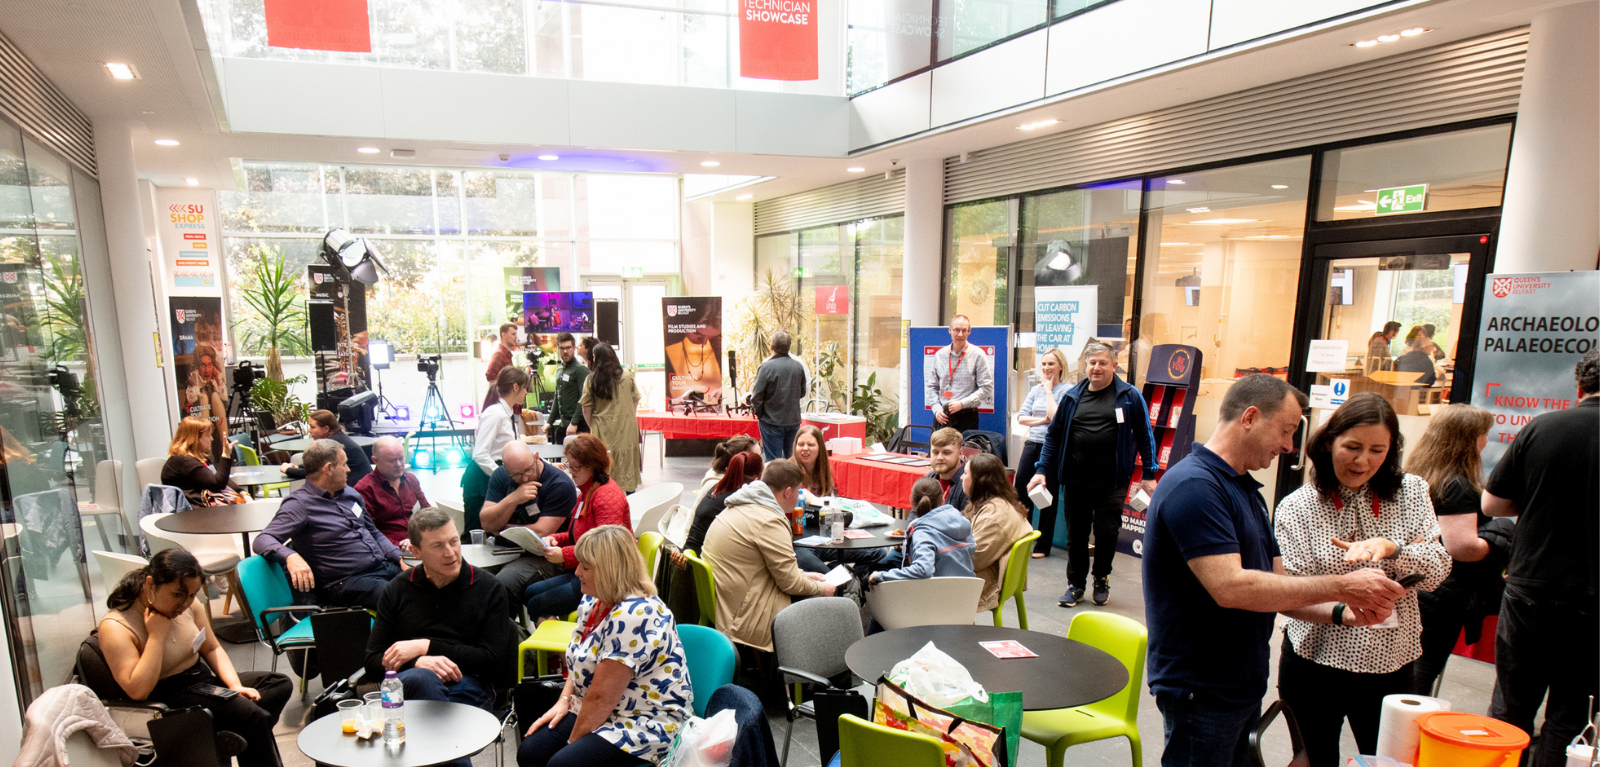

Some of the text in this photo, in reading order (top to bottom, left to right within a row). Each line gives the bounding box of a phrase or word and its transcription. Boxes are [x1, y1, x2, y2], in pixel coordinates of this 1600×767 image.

[743, 0, 810, 13] TECHNICIAN
[746, 9, 808, 25] SHOWCASE
[1405, 193, 1423, 204] Exit
[188, 204, 204, 214] SU
[170, 213, 204, 223] SHOP
[1038, 303, 1077, 312] CUT CARBON
[1038, 313, 1069, 322] EMISSIONS
[1037, 323, 1072, 333] BY LEAVING
[1487, 316, 1600, 332] ARCHAEOLO
[1037, 333, 1071, 343] THE CAR AT
[1176, 355, 1186, 365] BE
[1172, 360, 1186, 373] YOU
[190, 404, 212, 412] CULTIVATE
[1494, 395, 1540, 409] KNOW
[1543, 398, 1571, 411] THE
